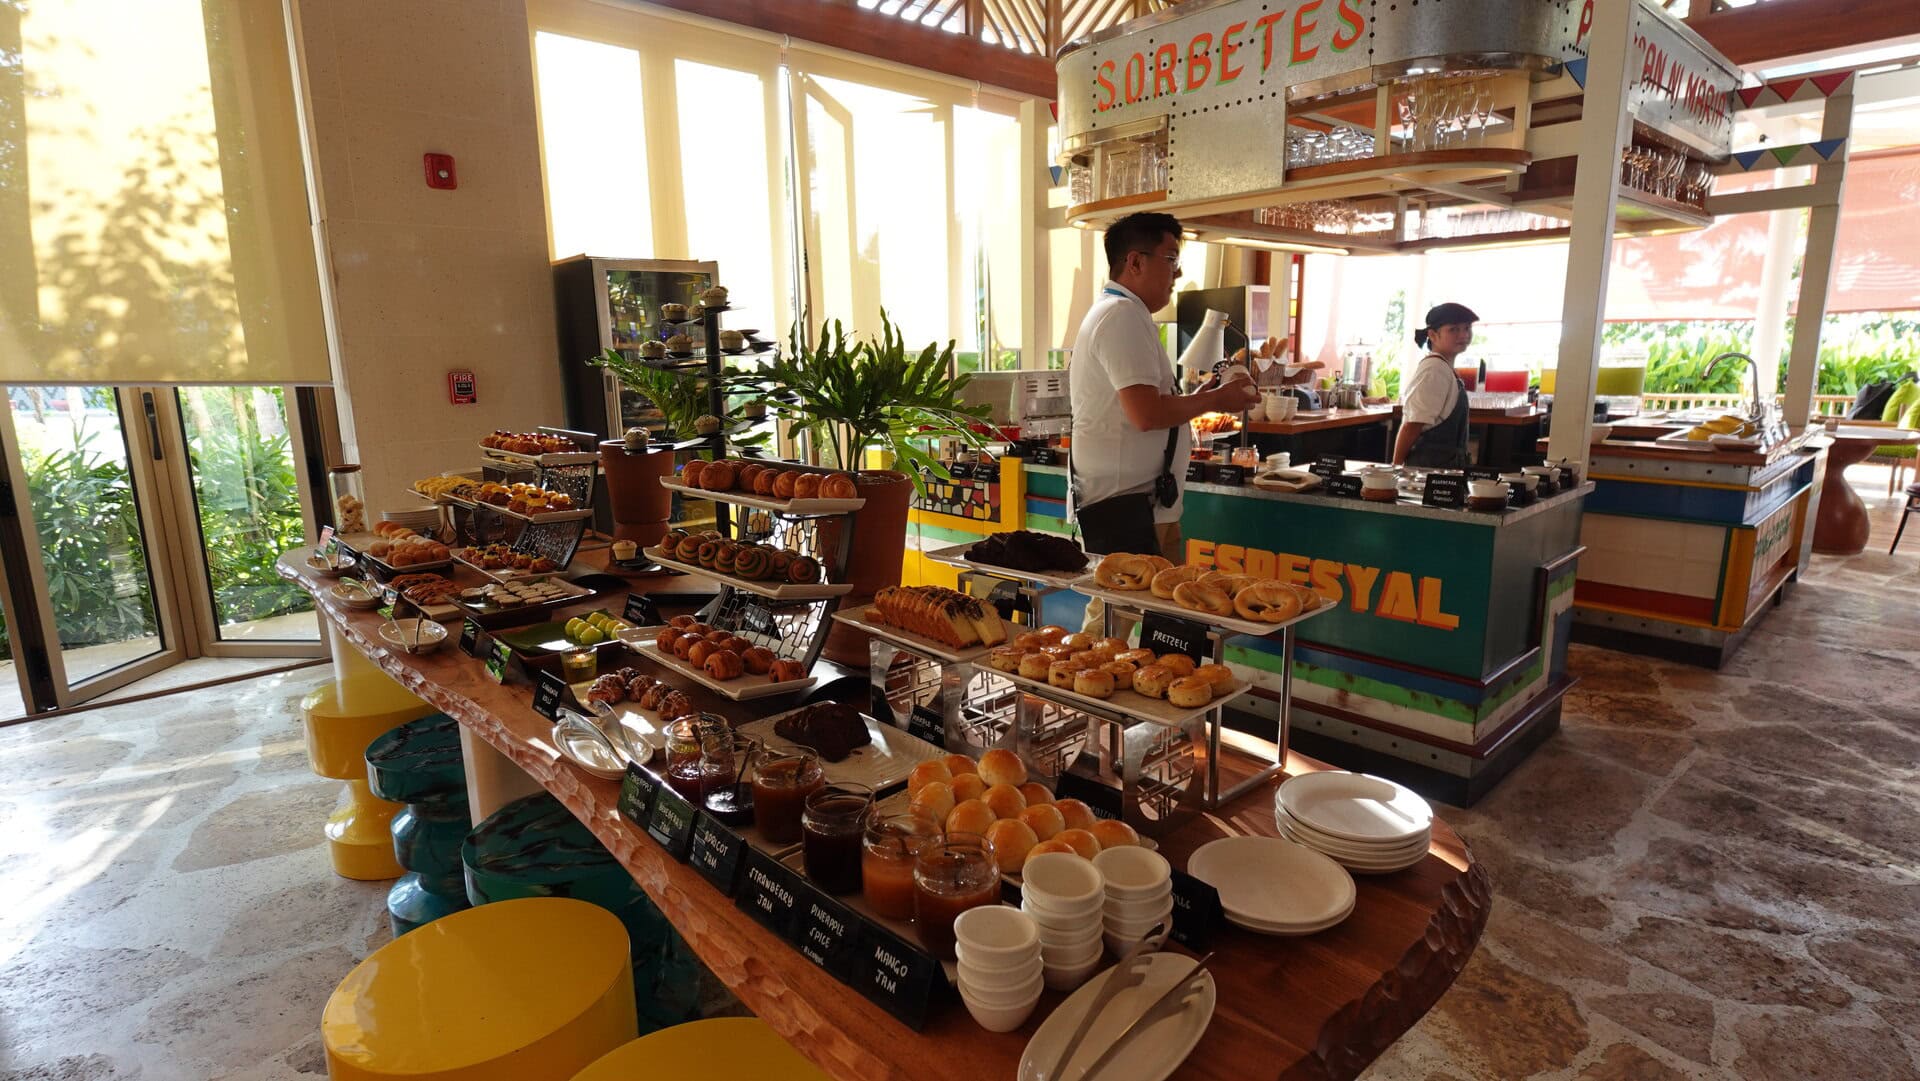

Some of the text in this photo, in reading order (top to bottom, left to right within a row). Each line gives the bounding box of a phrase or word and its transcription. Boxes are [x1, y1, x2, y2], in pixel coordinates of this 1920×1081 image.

[1096, 0, 1367, 113] SORBETES
[453, 374, 473, 382] FIRE
[1152, 629, 1190, 652] PRETZELS
[704, 829, 729, 857] APRICOT
[703, 850, 718, 869] JAM
[749, 866, 793, 909] STRAWBERRY
[756, 892, 773, 913] JAM
[810, 903, 845, 938] PINEAPPLE
[809, 926, 832, 949] SPICE
[874, 946, 909, 978] MANGO
[874, 968, 897, 995] JAM
